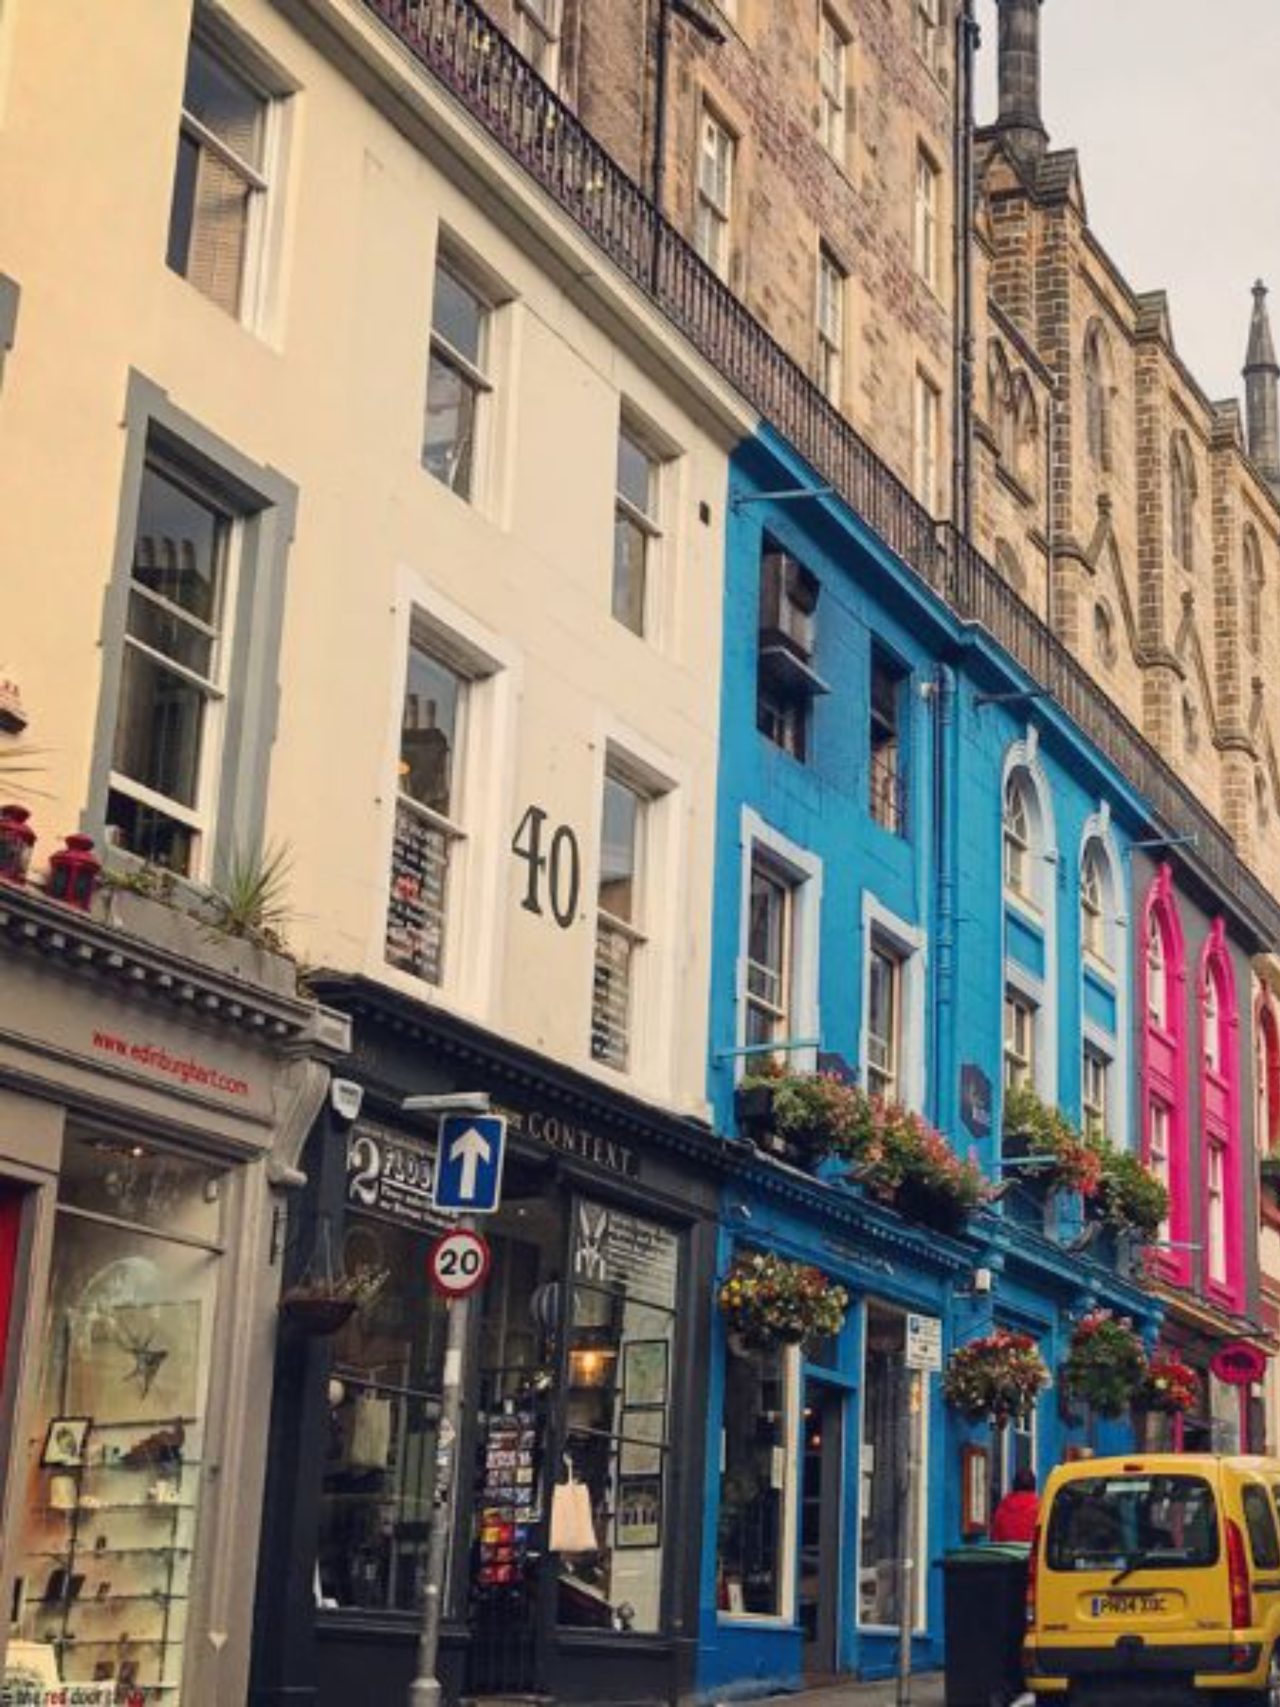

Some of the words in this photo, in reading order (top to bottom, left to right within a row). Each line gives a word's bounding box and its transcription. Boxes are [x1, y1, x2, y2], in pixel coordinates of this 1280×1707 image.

[511, 804, 579, 928] 40
[93, 1032, 248, 1094] www.edinburghart.com
[348, 1137, 380, 1204] 2
[440, 1249, 479, 1275] 20
